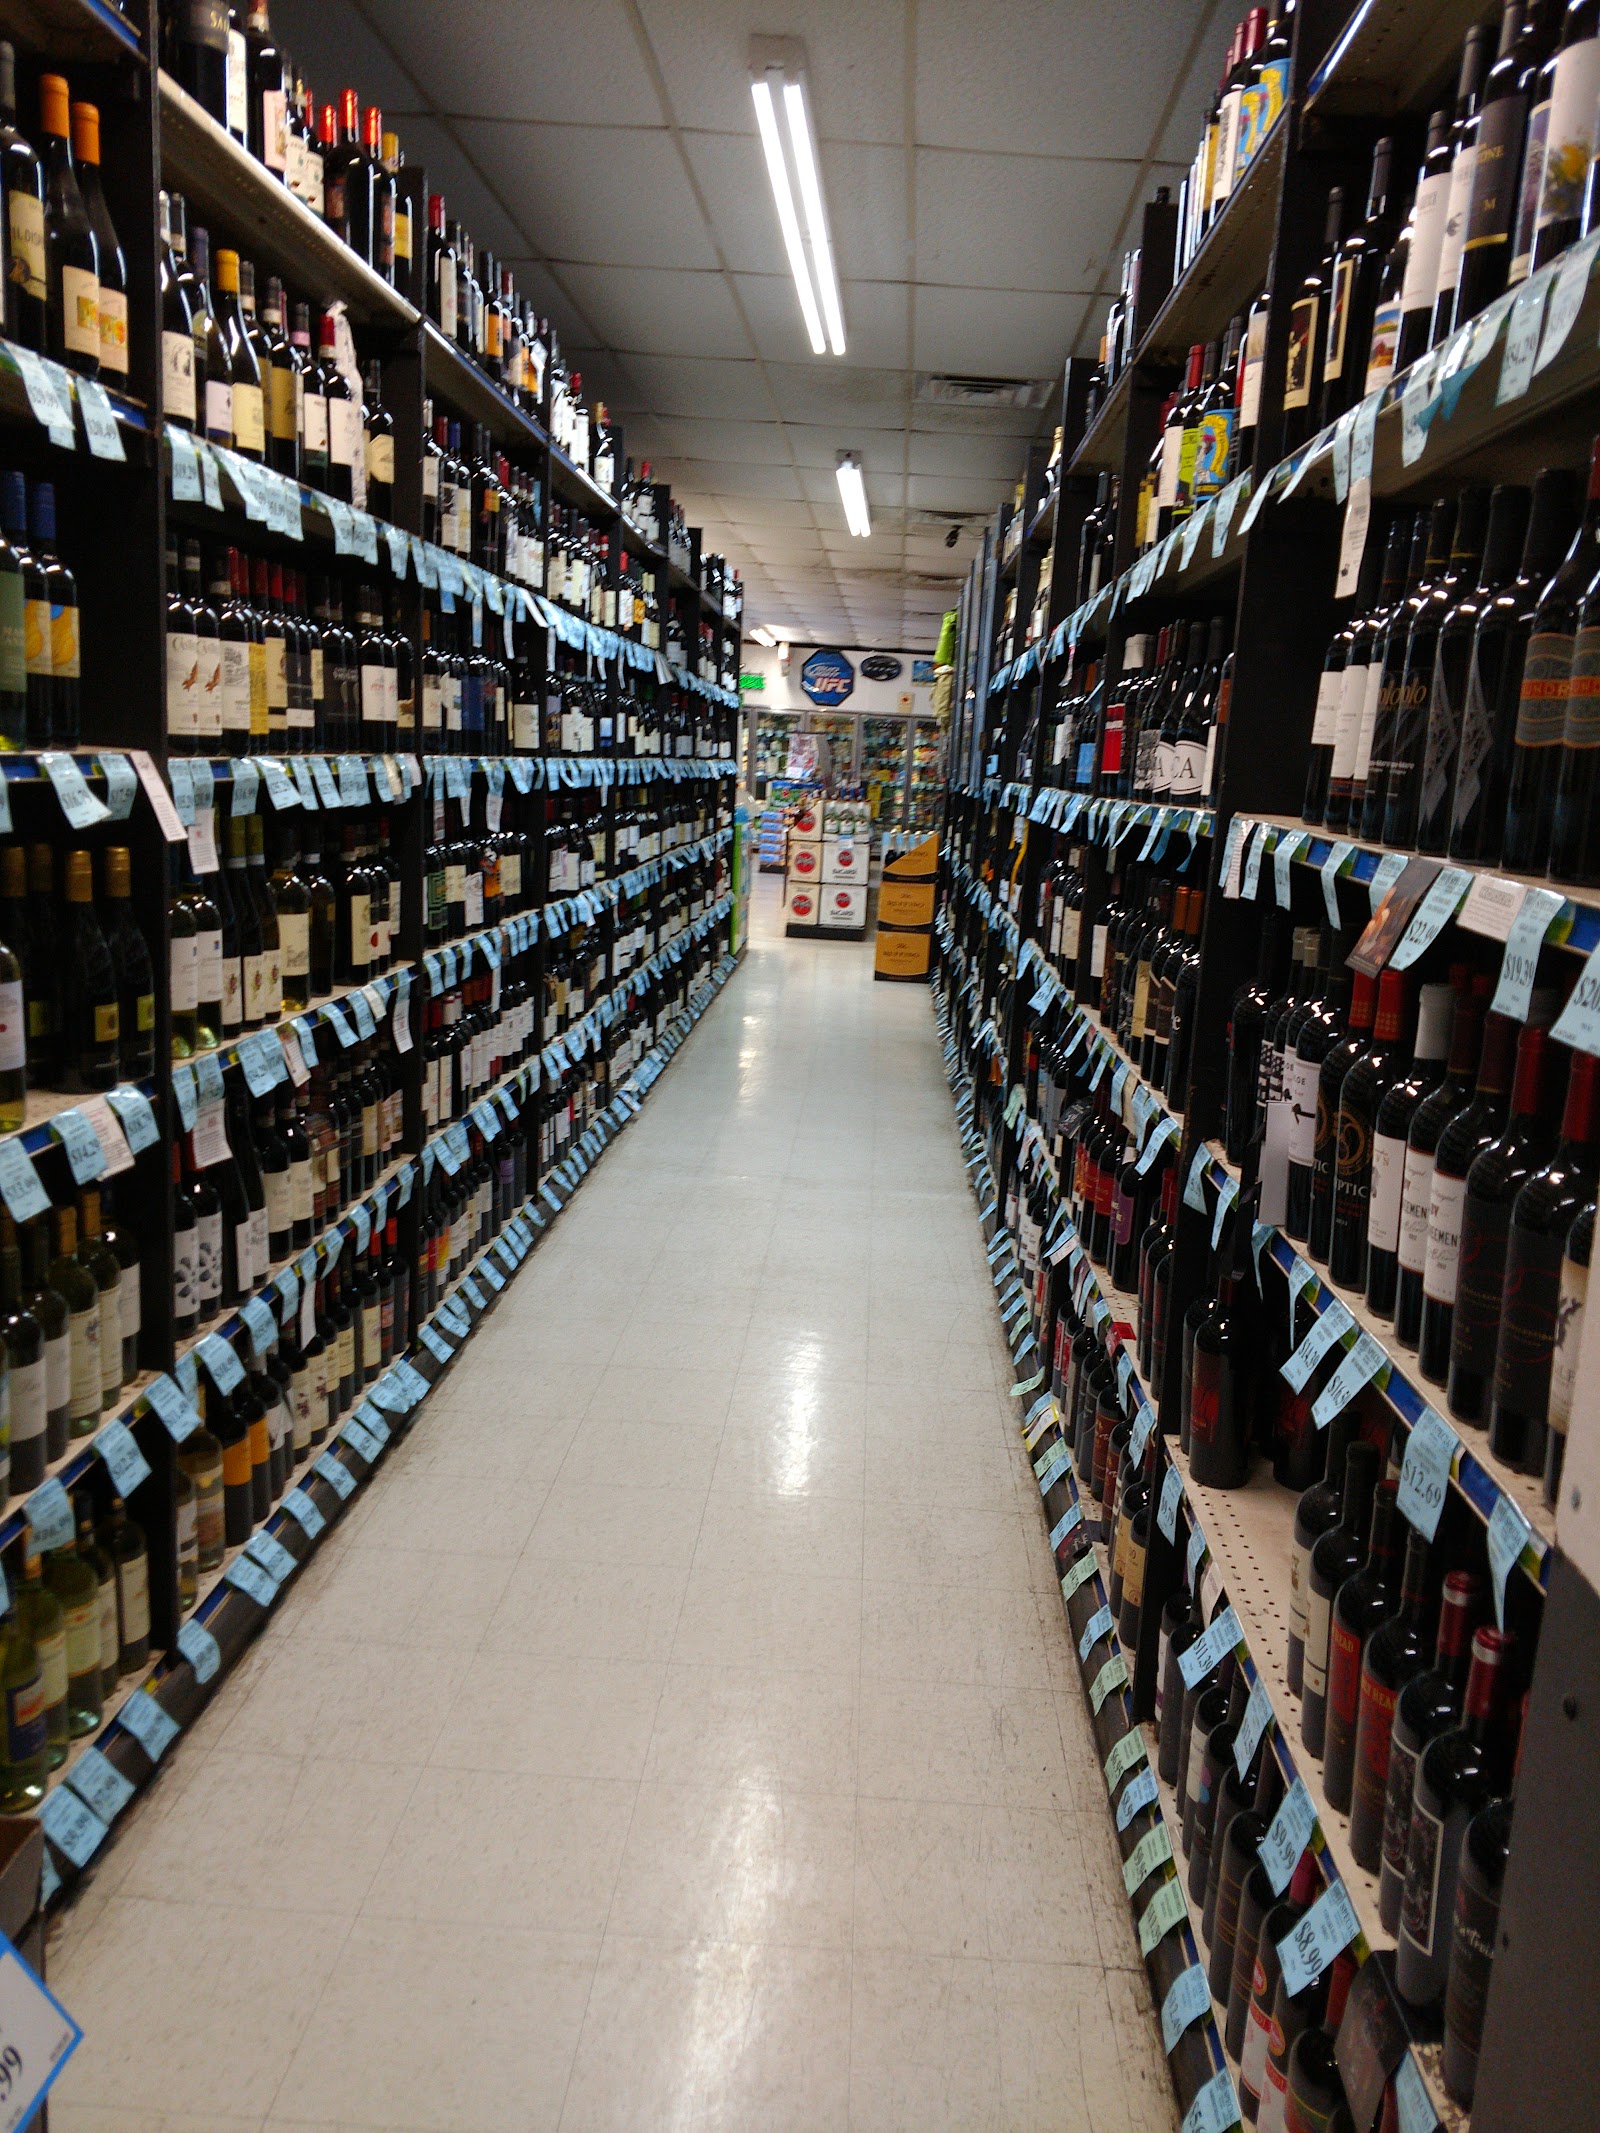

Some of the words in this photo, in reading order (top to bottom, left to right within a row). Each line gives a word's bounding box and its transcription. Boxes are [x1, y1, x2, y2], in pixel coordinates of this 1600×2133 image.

[814, 677, 851, 693] UFC
[1504, 953, 1536, 988] $19.39
[1403, 1458, 1442, 1509] $12.69
[1271, 1820, 1297, 1872] $9.99
[1294, 1920, 1324, 1977] $8.99
